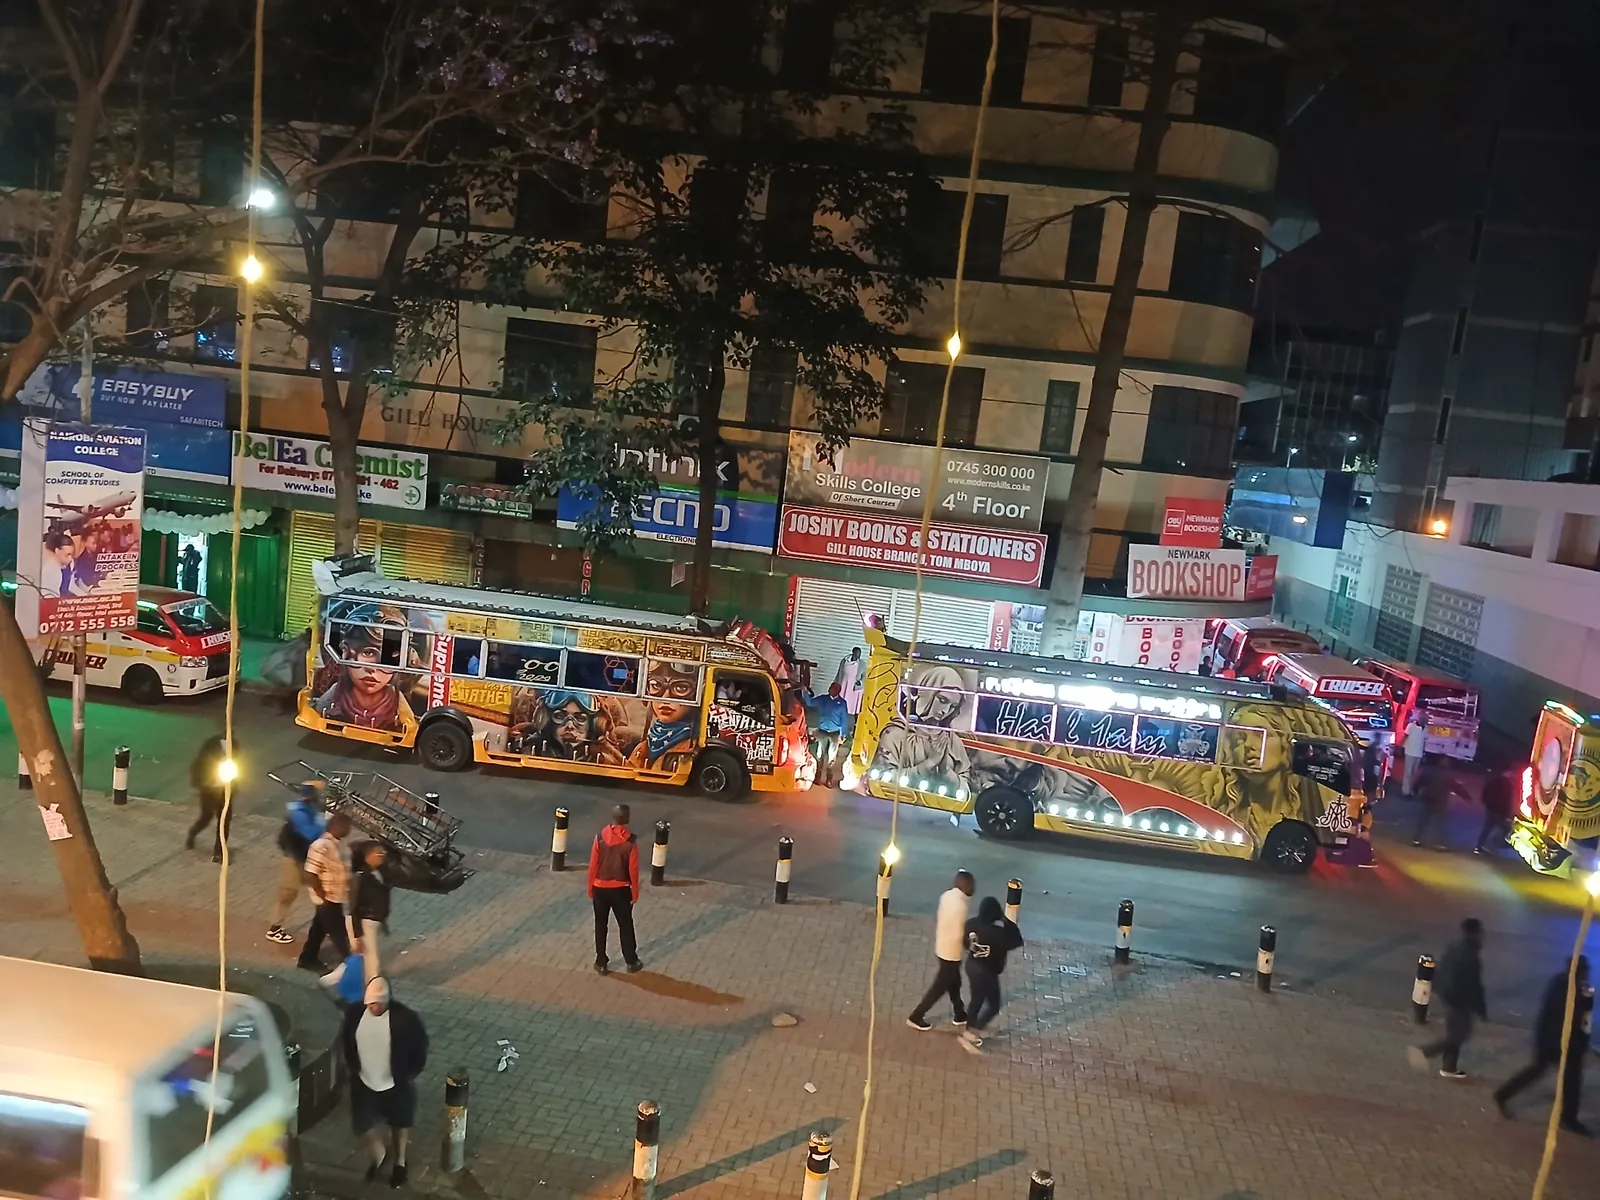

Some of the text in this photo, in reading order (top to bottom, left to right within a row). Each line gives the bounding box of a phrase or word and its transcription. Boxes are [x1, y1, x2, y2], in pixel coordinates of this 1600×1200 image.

[101, 379, 194, 400] EASYBUY
[160, 402, 182, 410] LATER
[180, 416, 223, 428] SAFARITECH
[381, 406, 430, 427] GILL
[74, 445, 119, 456] COLLEGE
[233, 433, 308, 466] BelEa
[259, 463, 275, 473] For
[277, 465, 319, 481] Delivery:
[947, 460, 1035, 480] 0745 300 000
[815, 473, 921, 499] Skills College
[947, 477, 1031, 492] www.modernskills.co.ke
[833, 493, 896, 508] Of Short Courses
[972, 496, 1031, 519] Floor
[788, 513, 1037, 562] JOSHY BOOKS & STATIONERS
[826, 542, 848, 555] GILL
[849, 545, 882, 559] HOUSE
[930, 554, 952, 567] TOM
[954, 558, 991, 573] MBOYA
[1167, 549, 1211, 560] NEWMARK
[96, 563, 138, 571] PROGRESS
[1132, 559, 1241, 597] BOOKSHOP
[79, 617, 105, 630] 555
[109, 616, 135, 628] 558
[432, 633, 452, 708] Supreme
[1319, 679, 1385, 696] CRUISER
